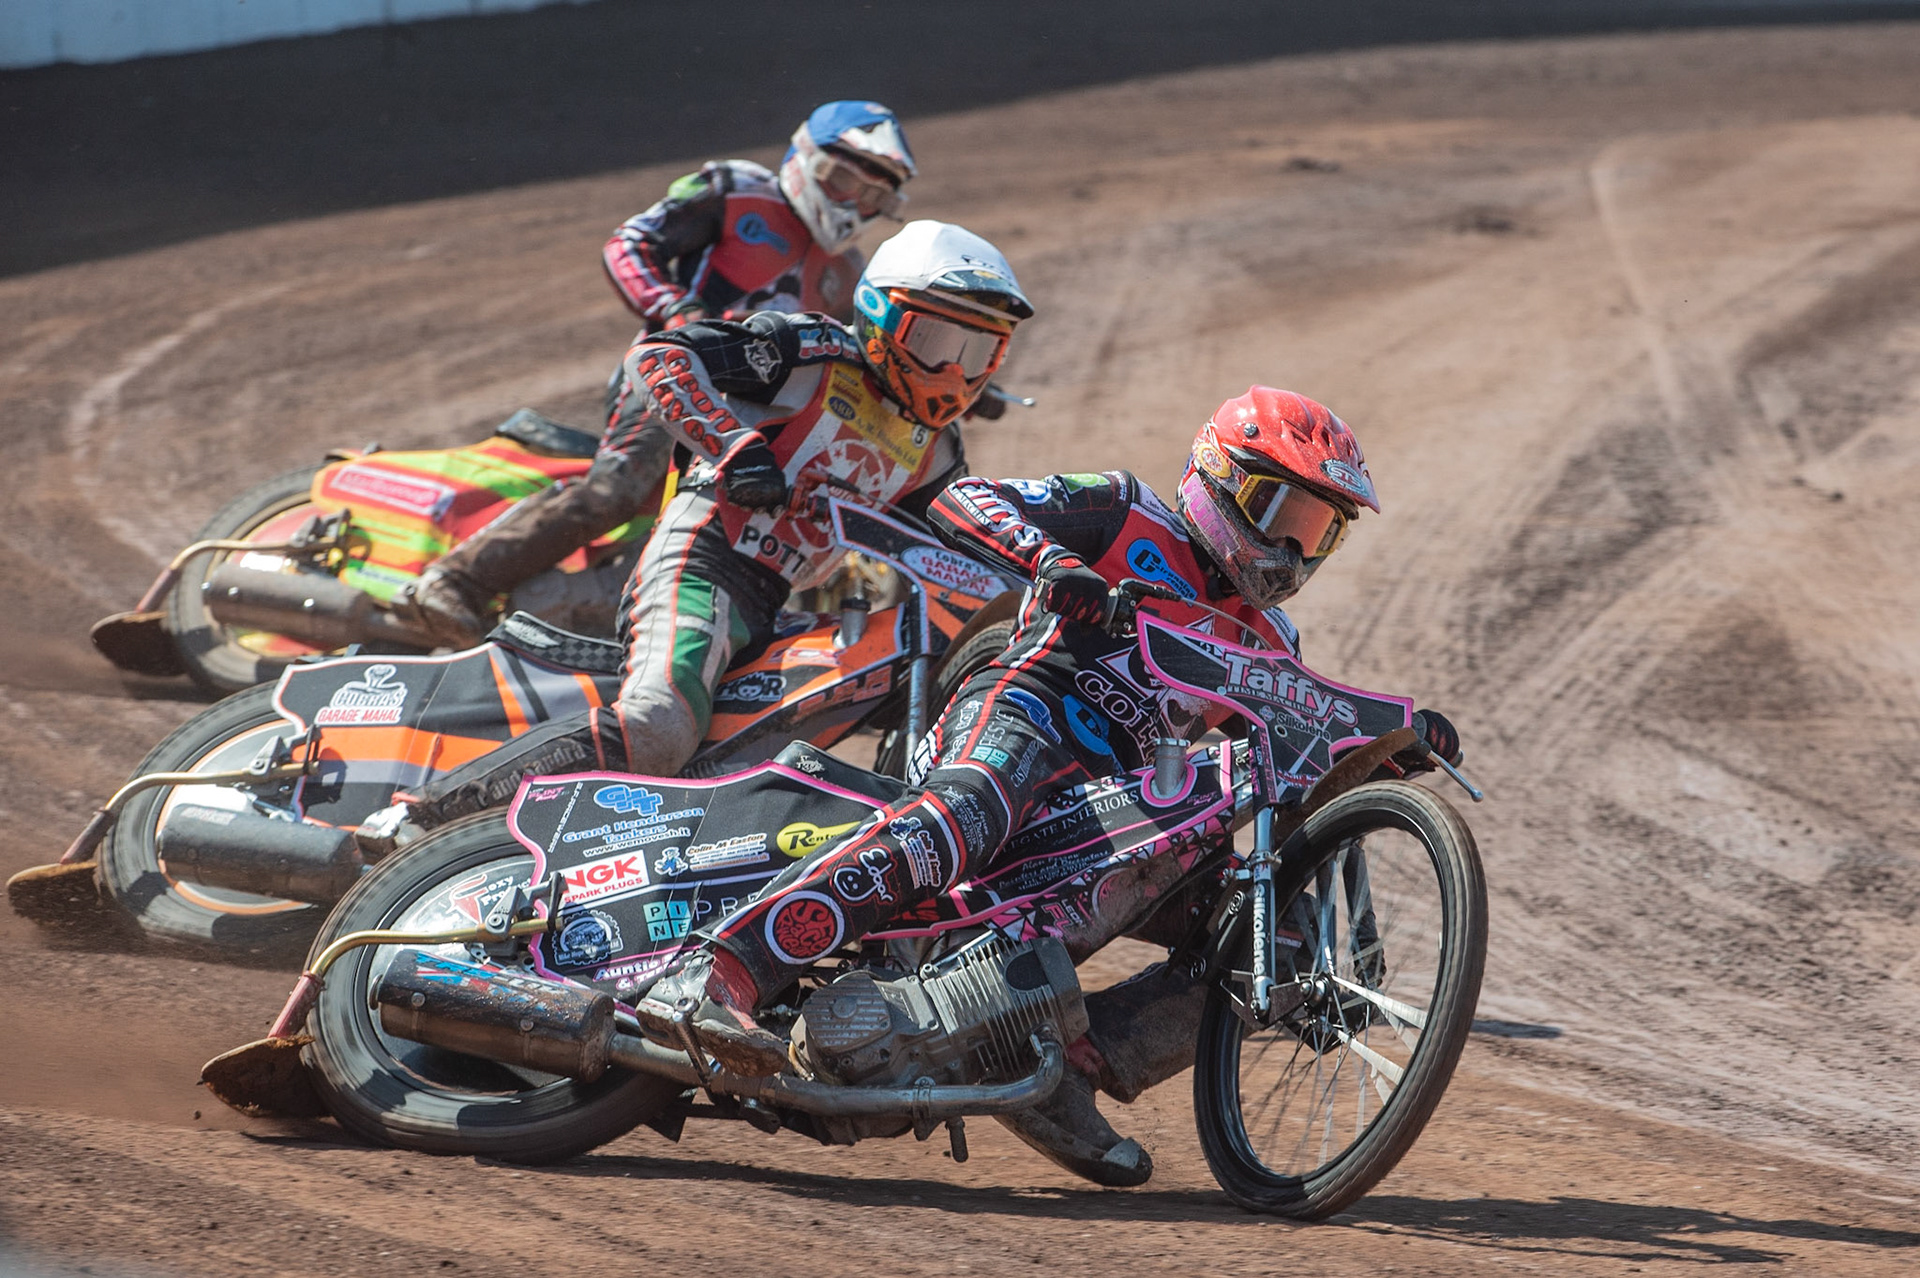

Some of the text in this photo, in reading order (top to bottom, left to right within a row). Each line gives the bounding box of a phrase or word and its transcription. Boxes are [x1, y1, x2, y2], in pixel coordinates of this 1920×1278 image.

[1224, 653, 1357, 724] Taffys
[317, 708, 400, 722] GARAGE MAHAL
[1276, 713, 1331, 742] Silkolene
[1061, 790, 1139, 830] INTERIORS
[563, 807, 705, 843] Grant Henderson
[602, 824, 668, 844] Tankers
[565, 856, 641, 888] NGK
[565, 877, 643, 904] SPARK PLUGS
[616, 977, 633, 991] &
